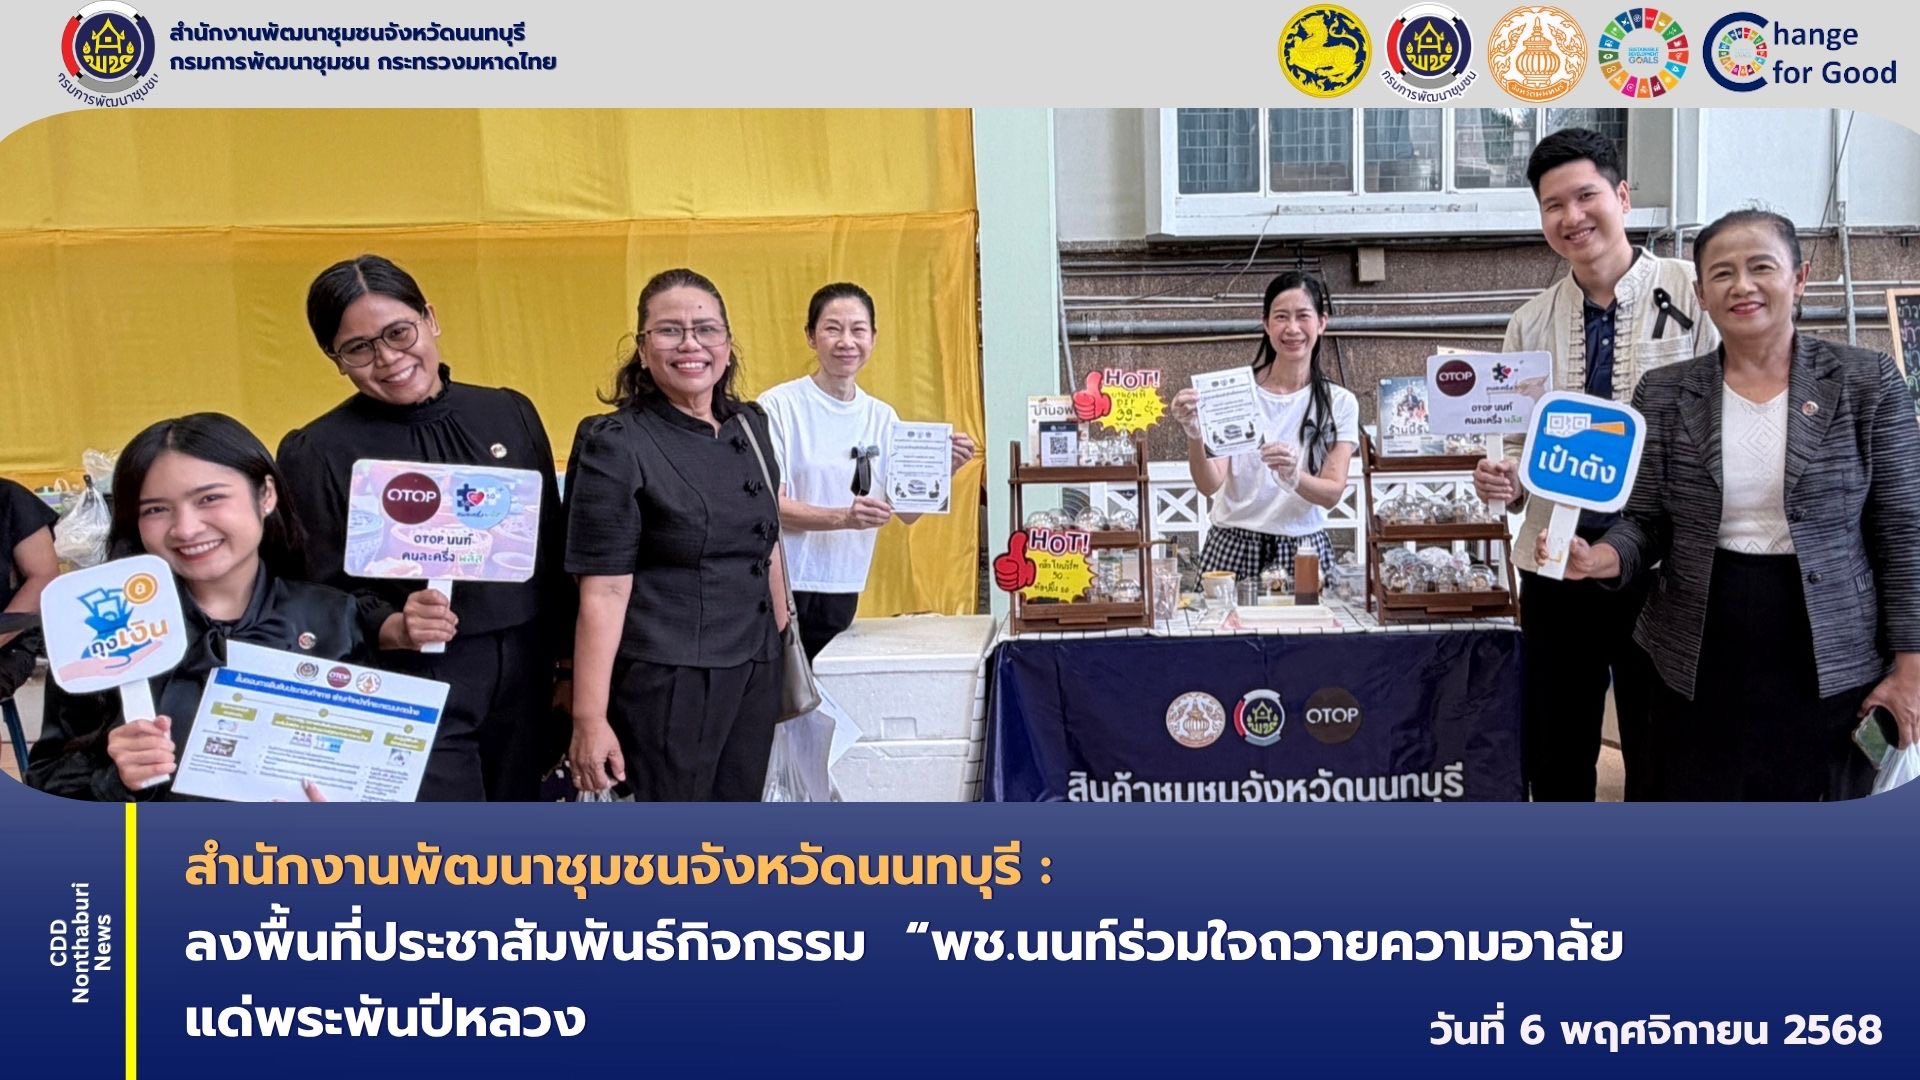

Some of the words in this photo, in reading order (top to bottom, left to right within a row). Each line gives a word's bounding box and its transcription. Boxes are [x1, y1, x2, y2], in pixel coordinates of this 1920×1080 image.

[1104, 369, 1160, 390] HOT!
[1439, 371, 1473, 382] OTOP
[1471, 404, 1493, 412] OTOP
[1494, 402, 1513, 412] นนท์
[1464, 413, 1502, 425] คนละครึ่ง
[1538, 444, 1616, 485] เป๋าตัง
[387, 488, 437, 503] OTOP
[413, 534, 444, 544] OTOP
[447, 533, 474, 545] นนท์
[1030, 529, 1089, 554] HOT!
[401, 547, 456, 562] คนละครึ่ง
[91, 619, 169, 657] ถุงเงิน
[1306, 707, 1359, 724] OTOP
